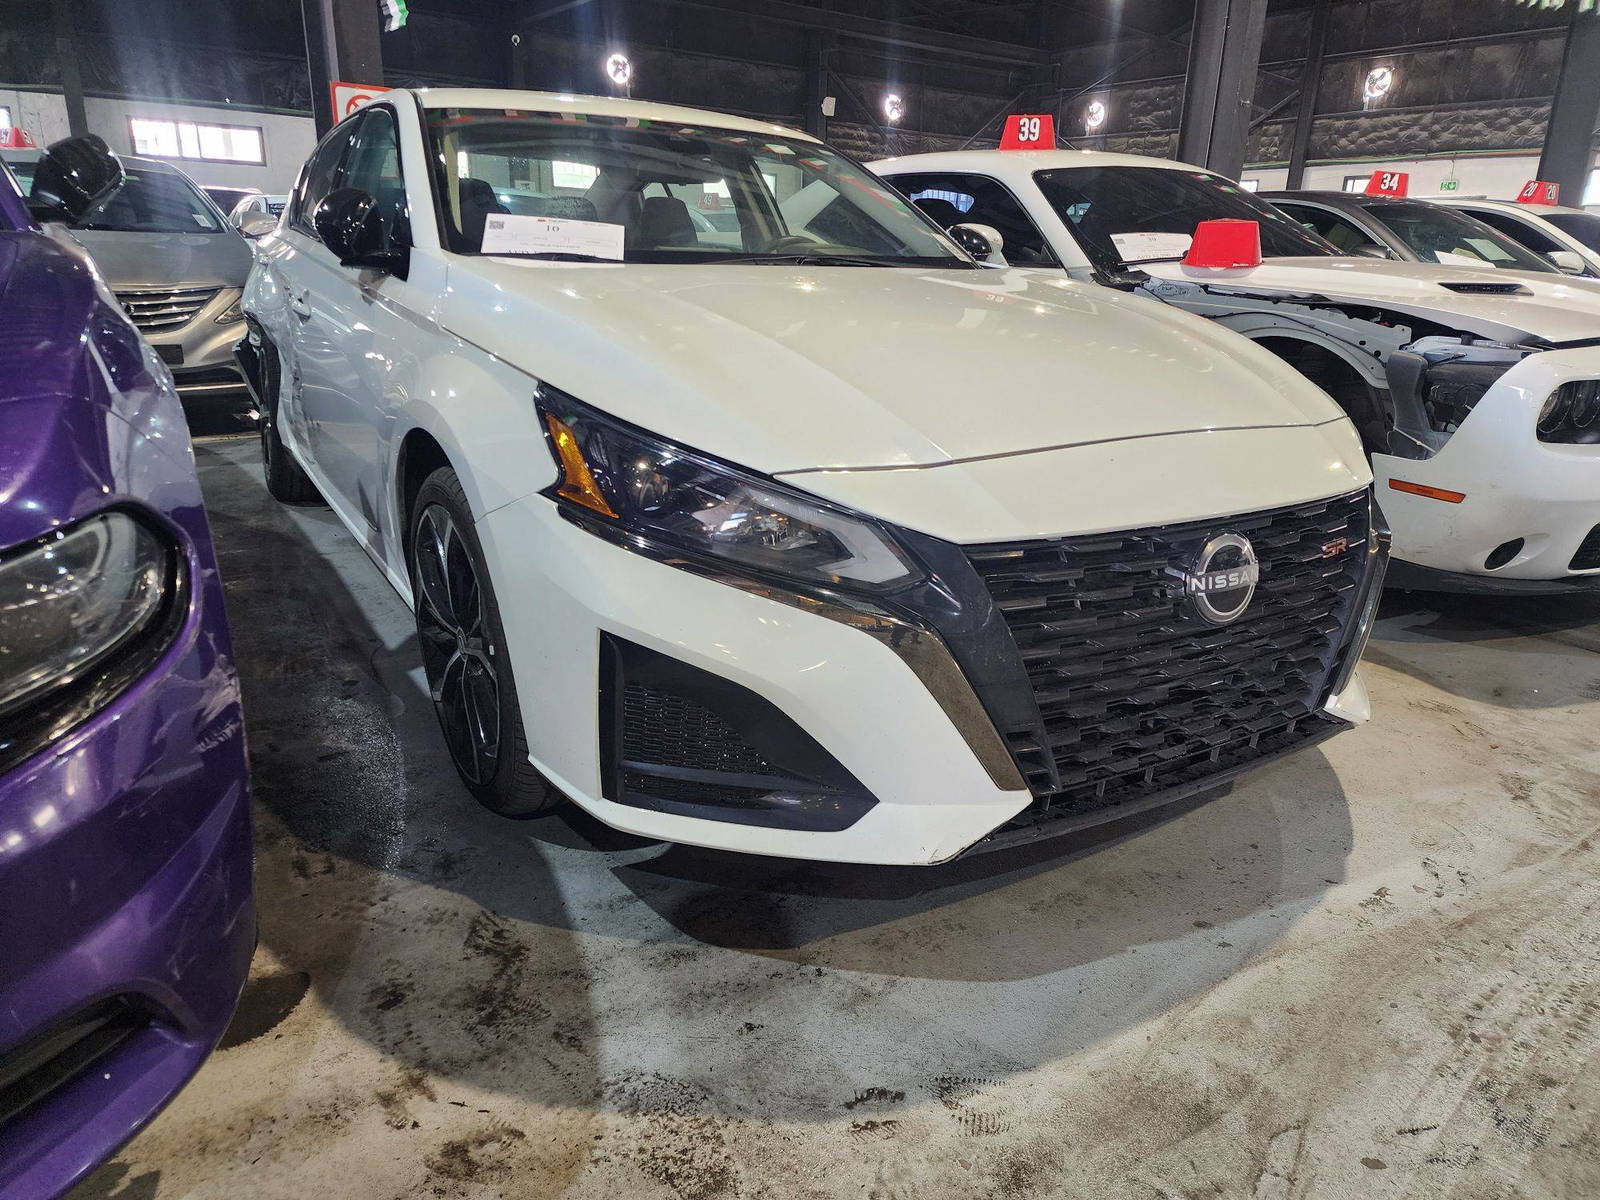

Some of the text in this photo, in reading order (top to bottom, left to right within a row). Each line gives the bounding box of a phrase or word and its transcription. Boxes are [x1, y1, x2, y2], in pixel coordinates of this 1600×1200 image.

[1018, 117, 1041, 142] 39
[1380, 173, 1400, 191] 34
[1523, 182, 1539, 198] 20
[546, 224, 560, 233] 10
[1321, 537, 1346, 558] SR
